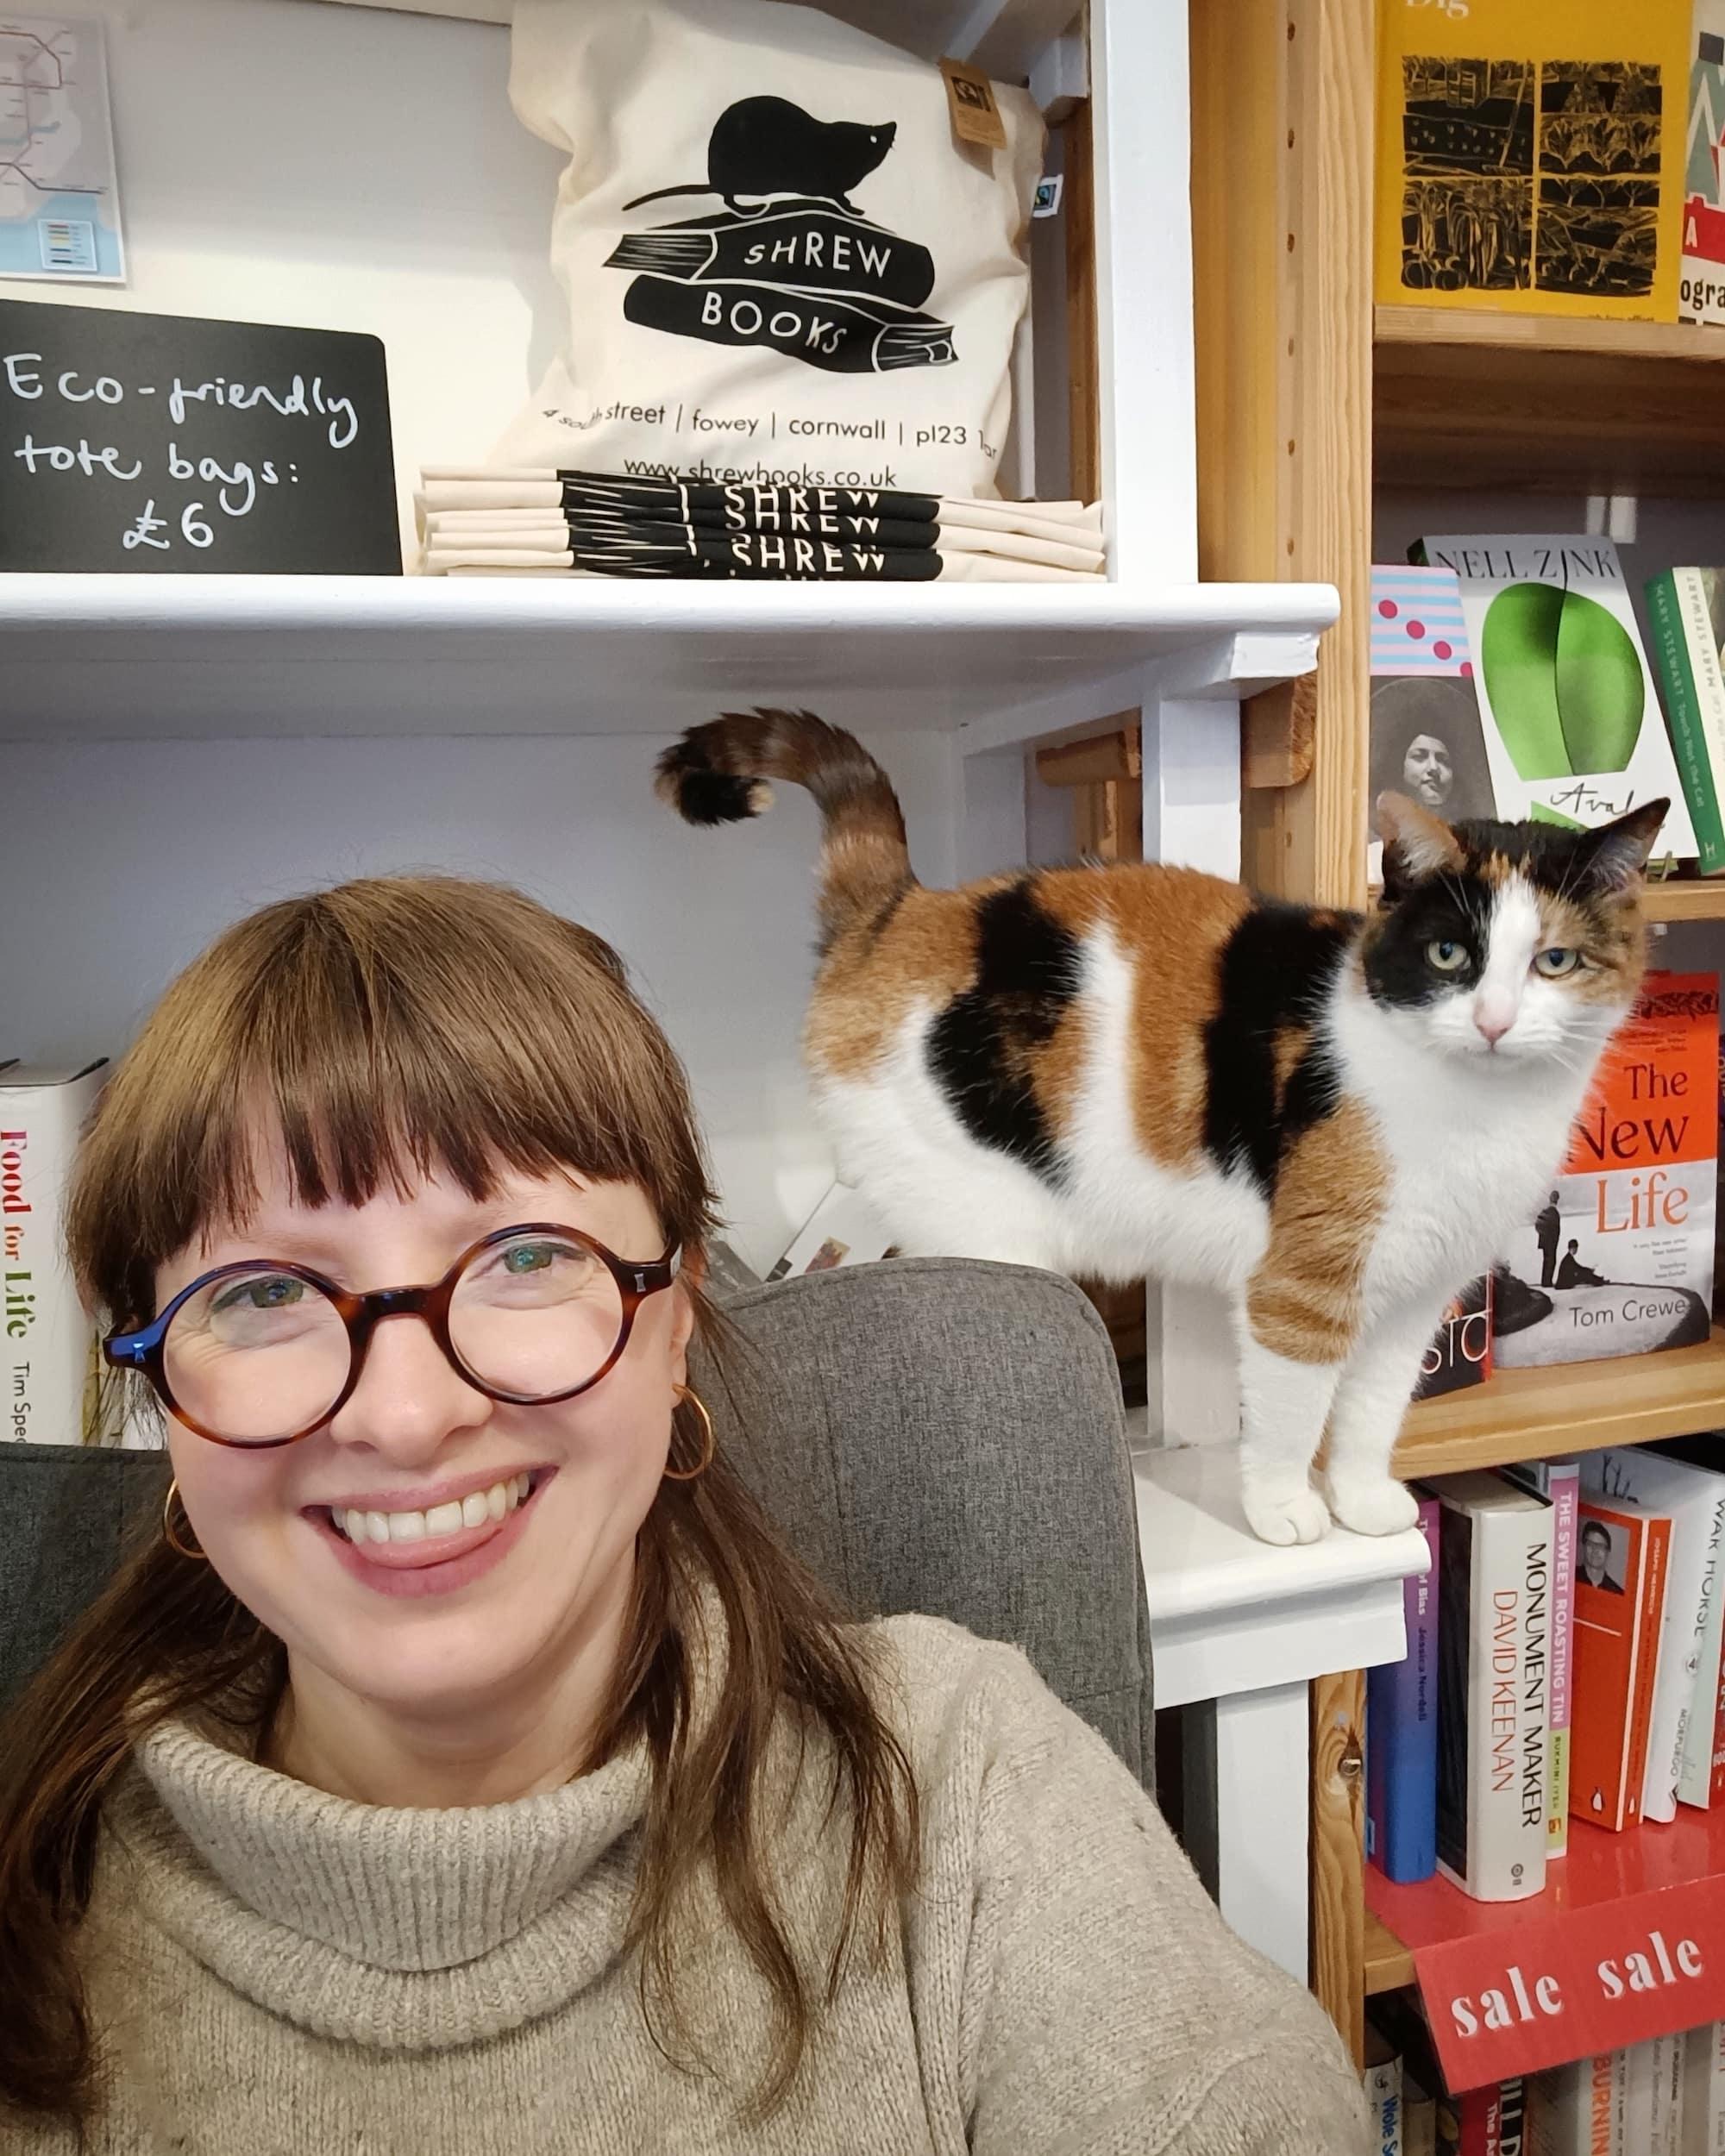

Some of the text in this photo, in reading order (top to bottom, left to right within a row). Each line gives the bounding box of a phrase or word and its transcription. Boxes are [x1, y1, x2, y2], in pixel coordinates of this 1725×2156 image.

[743, 231, 892, 279] SHREW
[701, 291, 848, 354] BOOKS
[3, 352, 359, 449] Eco-friendly
[605, 401, 666, 425] street
[693, 408, 758, 437] fowey
[788, 418, 886, 441] cornwall
[14, 434, 299, 517] tote bags:
[624, 458, 898, 490] wwwshrewbooks.co.uk
[724, 485, 880, 513] SHREW
[724, 507, 881, 533] SHREW
[122, 498, 215, 550] £6
[731, 533, 886, 573] SHREW
[1434, 548, 1617, 583] NELL ZINK
[1624, 1062, 1688, 1100] The
[1566, 1106, 1690, 1162] New
[1, 1130, 32, 1213] Food
[1596, 1171, 1689, 1233] Life
[4, 1225, 25, 1261] for
[5, 1271, 36, 1338] Life
[1569, 1299, 1687, 1328] Tom Crewe
[13, 1361, 31, 1398] Tim
[1552, 1491, 1572, 1724] THE SWEET ROASTING TIN
[1490, 1590, 1519, 1792] DAVID KEENAN
[1521, 1542, 1547, 1828] MONUMENT MAKER
[1451, 1931, 1704, 2039] sale sale
[1382, 2093, 1398, 2139] Wole
[1486, 2102, 1498, 2134] The
